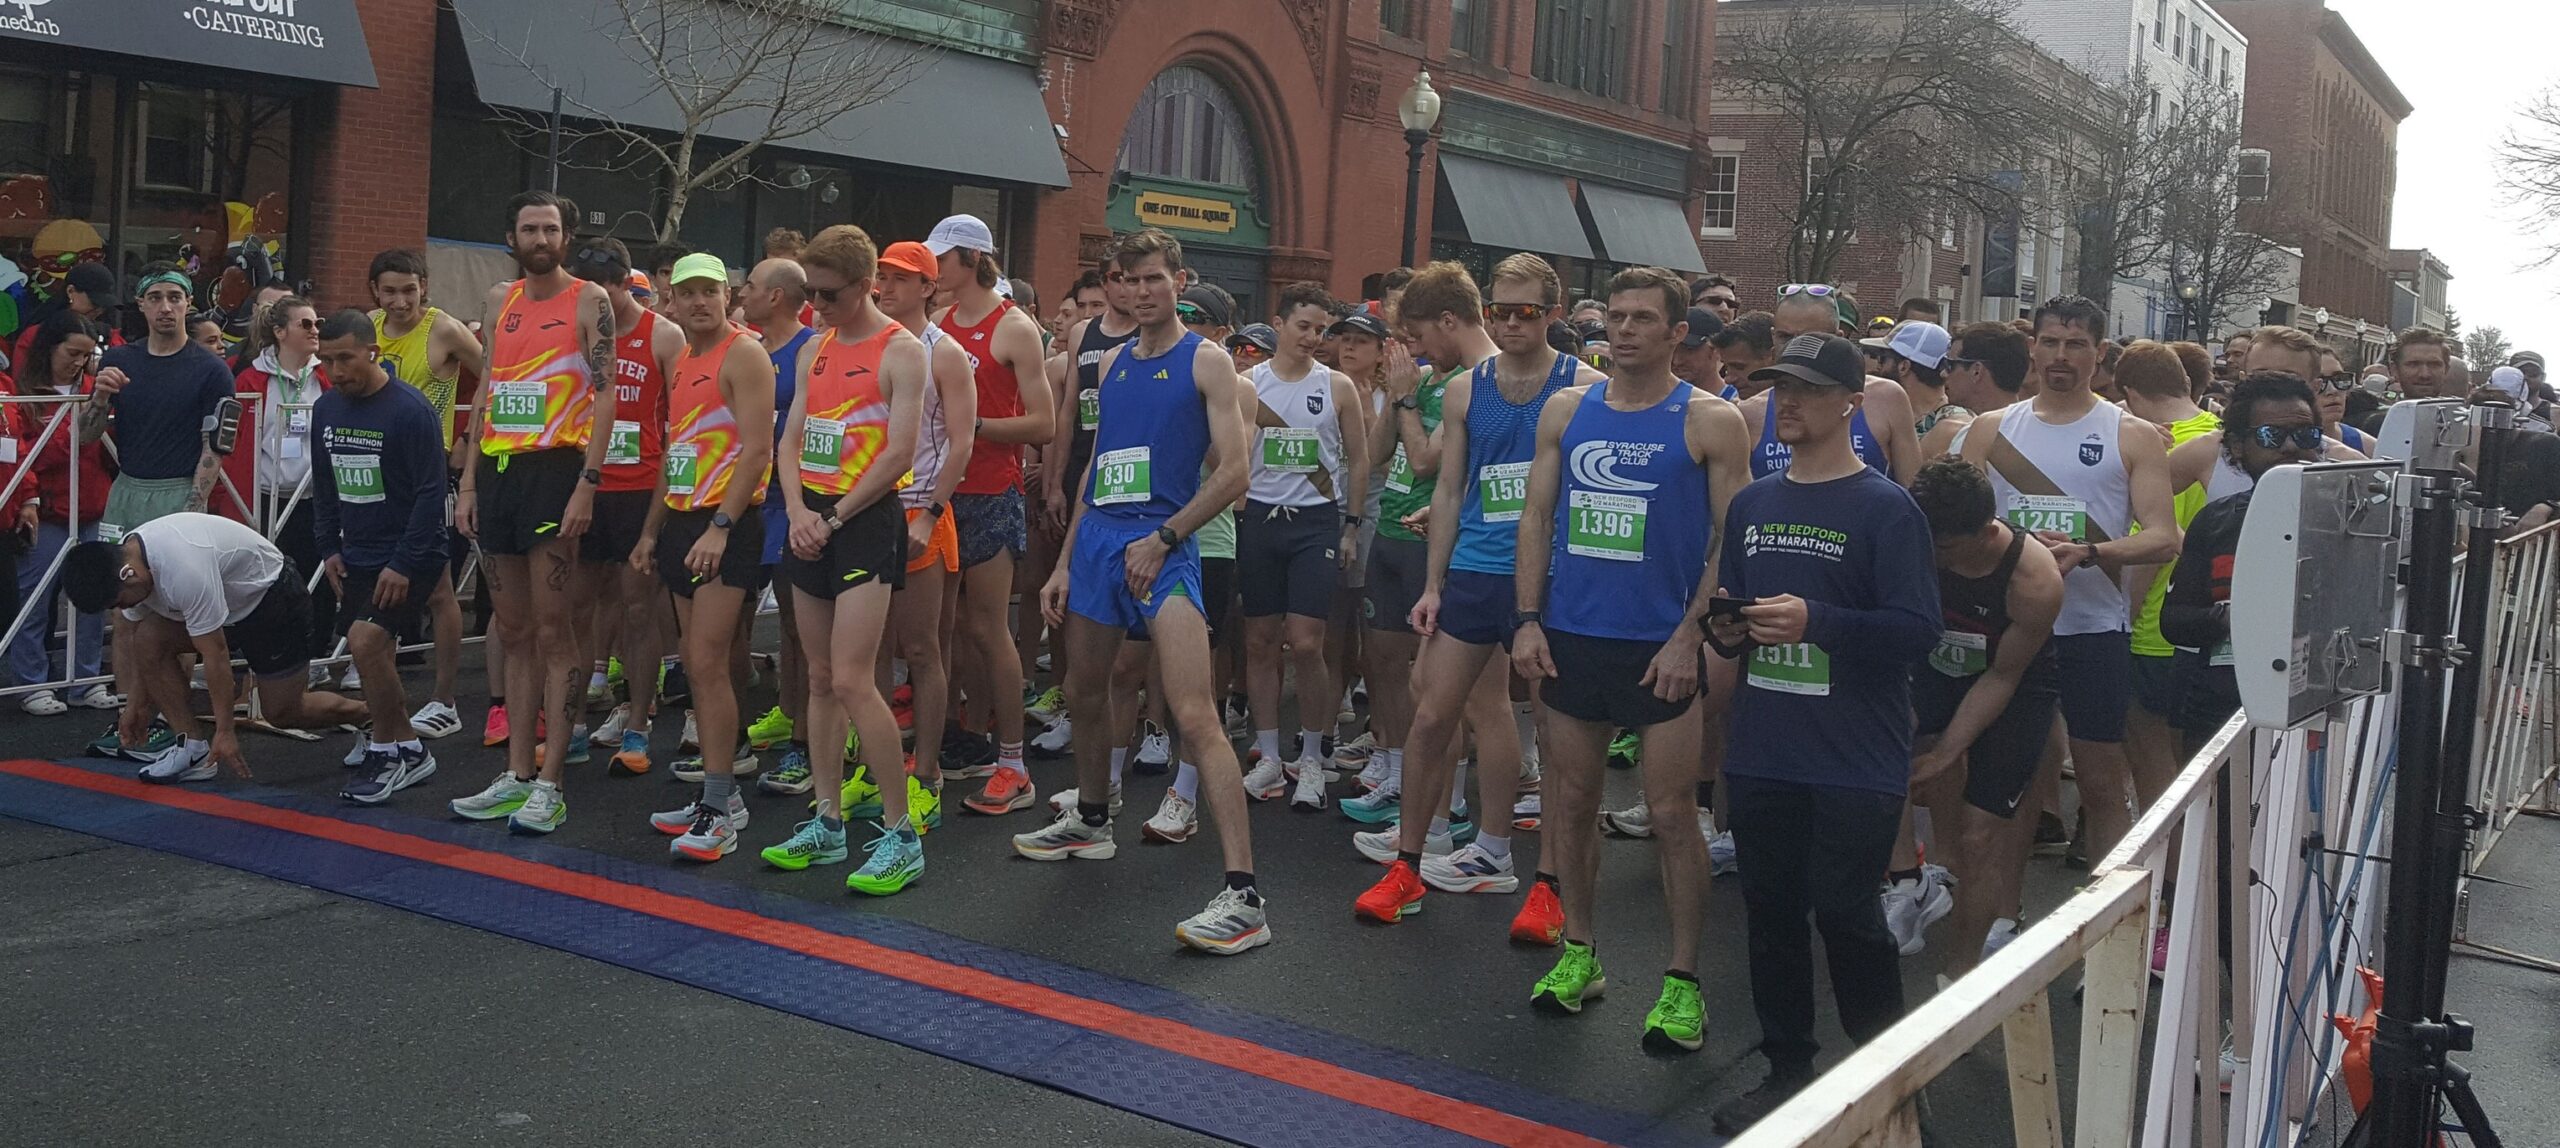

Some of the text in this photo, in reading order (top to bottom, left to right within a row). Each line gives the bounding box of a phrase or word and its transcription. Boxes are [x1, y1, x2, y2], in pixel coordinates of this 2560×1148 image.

[192, 7, 325, 48] CATERING
[1143, 202, 1230, 222] ONE CITY HALL SQUARE
[498, 395, 537, 415] 1539
[804, 432, 834, 455] 1538
[1277, 440, 1306, 457] 741
[1607, 441, 1665, 452] SYRACUSE
[1618, 449, 1653, 458] TRACK
[1620, 457, 1648, 466] CLUB
[339, 468, 374, 486] 1440
[1104, 463, 1135, 486] 830
[1602, 501, 1637, 509] MARATHON
[1579, 510, 1633, 538] 1396
[2017, 511, 2074, 534] 1245
[1762, 523, 1847, 544] NEW BEDFORD
[1760, 535, 1845, 556] 1/2 MARATHON
[1756, 643, 1813, 668] 1511
[787, 840, 826, 856] BROOKS
[873, 854, 907, 881] BROOKS
